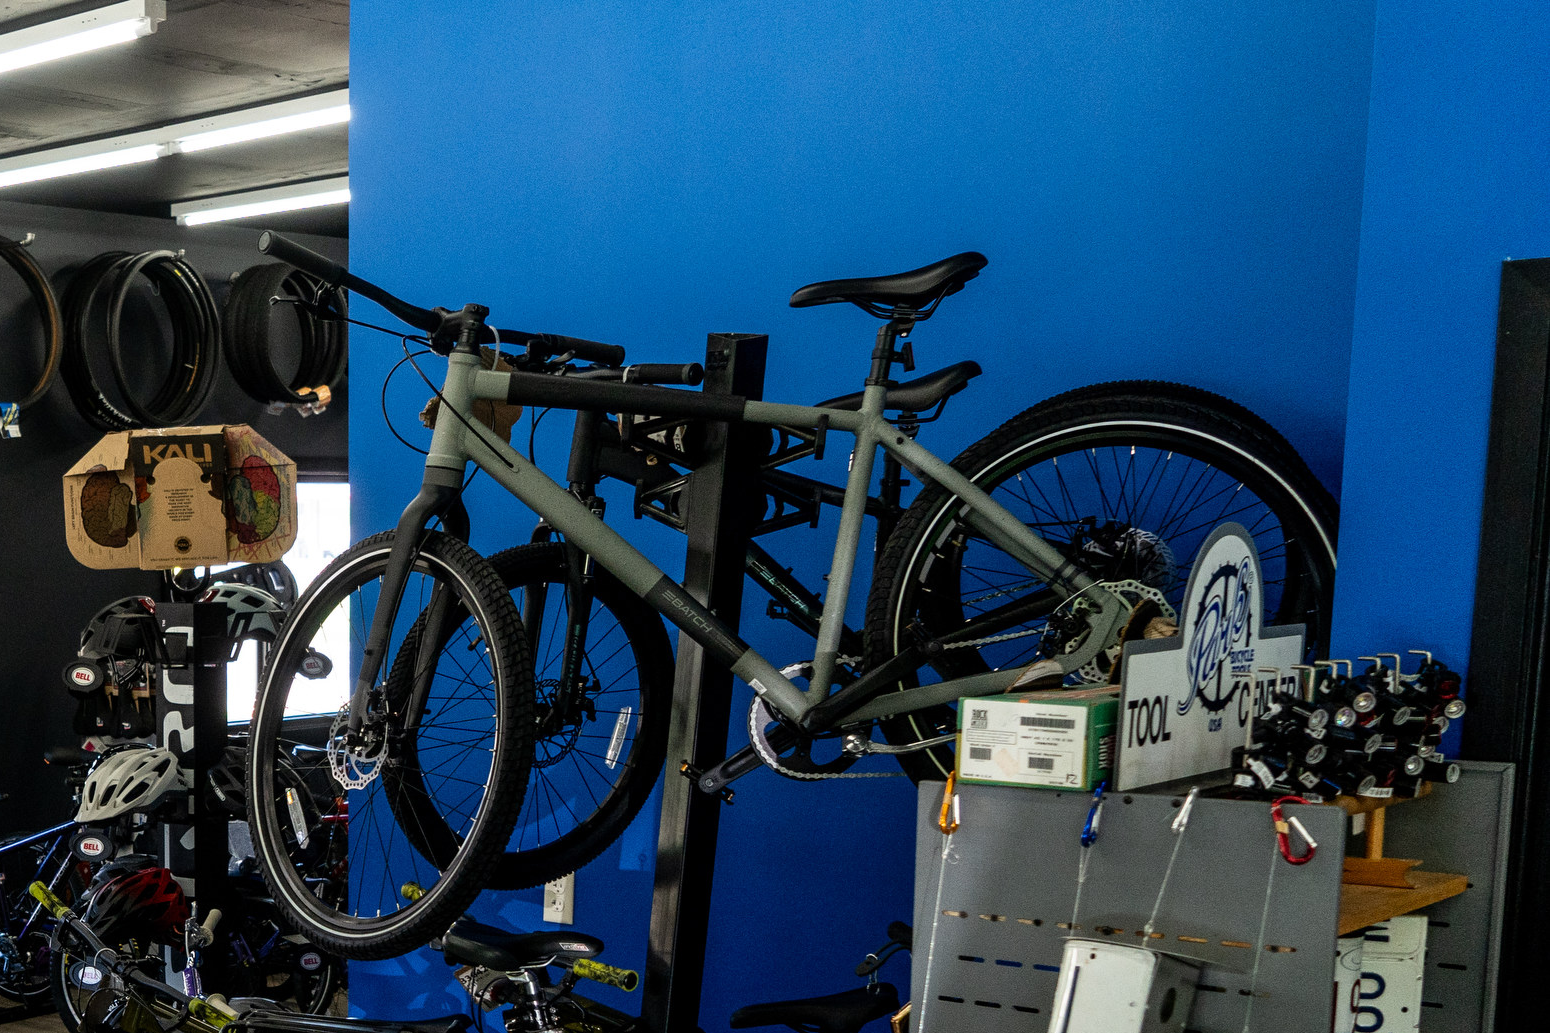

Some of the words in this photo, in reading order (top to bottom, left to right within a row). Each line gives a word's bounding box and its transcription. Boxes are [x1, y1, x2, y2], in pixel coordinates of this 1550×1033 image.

[142, 443, 213, 465] KALI
[1230, 649, 1254, 664] BICYCLE
[305, 661, 318, 670] BELL
[75, 672, 91, 682] BELL
[1127, 695, 1171, 749] TOOL
[1238, 675, 1299, 728] CENR
[83, 842, 100, 851] BELL
[303, 956, 318, 966] BELL
